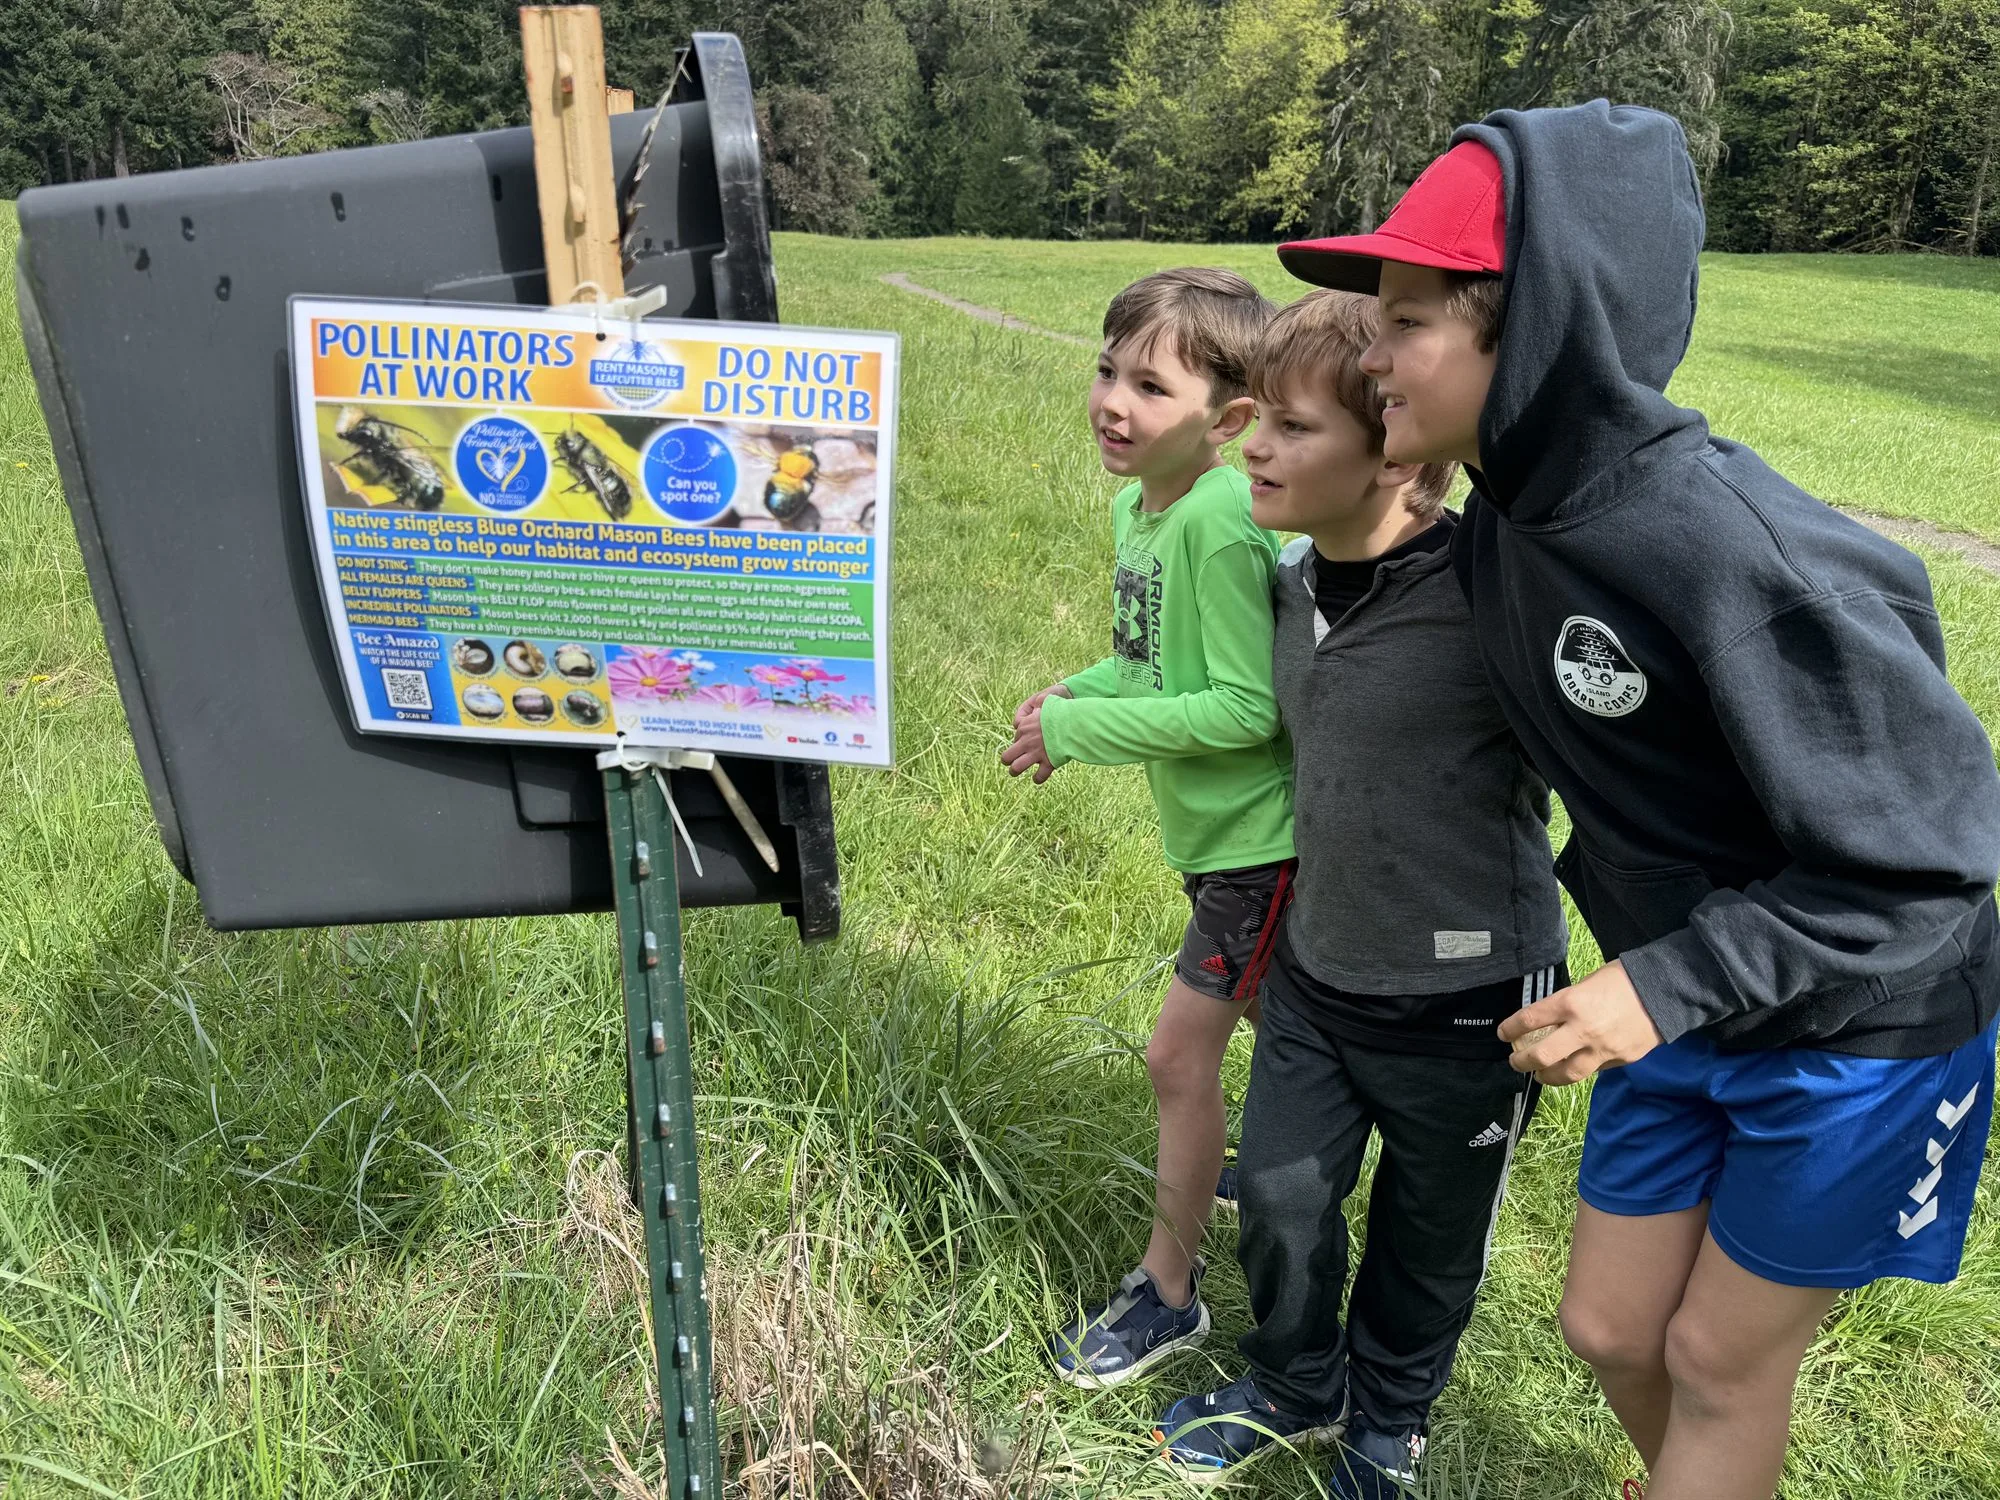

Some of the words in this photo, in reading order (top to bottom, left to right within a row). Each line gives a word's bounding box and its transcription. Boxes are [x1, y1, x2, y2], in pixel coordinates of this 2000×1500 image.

[319, 323, 574, 367] POLLINATORS
[595, 362, 624, 374] RENT
[626, 363, 666, 376] MASON
[669, 367, 679, 377] &
[718, 346, 771, 380] DO
[784, 350, 861, 385] NOT
[360, 363, 403, 396] AT
[414, 364, 532, 402] WORK
[595, 374, 653, 386] LEAFCUTTER
[655, 377, 679, 388] BEES
[704, 381, 871, 422] DISTURB
[472, 424, 527, 438] Pollinator
[463, 434, 507, 450] Friendly
[508, 438, 538, 453] Yard
[667, 476, 691, 490] Can
[692, 480, 717, 493] you
[479, 492, 496, 504] NO
[661, 491, 688, 504] spot
[690, 492, 721, 504] one?
[332, 512, 390, 530] Native
[394, 515, 473, 536] stingless
[477, 518, 518, 536] Blue
[522, 521, 594, 540] Orchard
[599, 525, 657, 544] Mason
[662, 528, 705, 546] Bees
[709, 531, 752, 549] have
[756, 534, 802, 552] been
[807, 537, 867, 556] placed
[333, 530, 350, 546] in
[354, 531, 388, 548] this
[392, 537, 430, 550] area
[434, 538, 452, 552] to
[456, 537, 497, 558] help
[501, 543, 530, 556] our
[535, 540, 600, 560] habitat
[604, 547, 638, 562] and
[641, 552, 738, 570] ecosystem
[742, 556, 788, 573] grow
[792, 559, 870, 578] stronger
[337, 557, 353, 567] DO
[354, 558, 376, 568] NOT
[377, 559, 408, 570] STING
[421, 562, 443, 575] They
[445, 564, 471, 574] don't
[474, 565, 499, 575] make
[500, 567, 531, 579] honey
[534, 568, 551, 579] and
[553, 570, 576, 580] have
[580, 572, 592, 580] no
[594, 572, 615, 582] hive
[629, 576, 661, 586] queen
[663, 578, 673, 586] to
[675, 579, 714, 589] protect,
[730, 580, 753, 593] they
[754, 583, 770, 591] are
[772, 583, 850, 596] non-aggressive.
[341, 571, 358, 582] ALL
[359, 572, 403, 584] FEMALES
[405, 575, 424, 585] ARE
[426, 576, 467, 588] QUEENS
[479, 579, 502, 592] They
[504, 582, 520, 590] are
[522, 583, 560, 596] solitary
[590, 586, 613, 597] each
[615, 588, 649, 599] female
[651, 591, 671, 602] lays
[673, 591, 689, 601] her
[691, 595, 713, 603] own
[715, 596, 737, 607] eggs
[740, 596, 758, 605] and
[760, 596, 784, 606] finds
[786, 598, 803, 608] her
[805, 602, 826, 610] own
[828, 602, 852, 611] nest.
[342, 585, 370, 596] BELLY
[372, 587, 422, 599] FLOPPERS
[432, 591, 464, 602] Mason
[466, 593, 489, 603] bees
[490, 594, 518, 605] BELLY
[520, 596, 544, 606] FLOP
[547, 599, 569, 608] onto
[571, 599, 608, 610] flowers
[610, 603, 627, 612] and
[629, 605, 646, 615] get
[648, 606, 679, 616] pollen
[681, 607, 694, 616] all
[696, 609, 717, 617] over
[720, 609, 742, 619] their
[745, 610, 770, 623] body
[772, 612, 796, 622] hairs
[798, 613, 828, 623] called
[829, 615, 865, 626] SCOPA.
[346, 600, 403, 612] INCREDIBLE
[404, 603, 472, 616] POLLINATORS
[482, 609, 513, 619] Mason
[515, 610, 538, 620] bees
[541, 612, 561, 622] visit
[564, 614, 591, 624] 2,000
[593, 616, 630, 626] flowers
[659, 621, 677, 629] and
[678, 622, 722, 632] pollinate
[725, 624, 749, 634] 95%
[750, 626, 760, 634] of
[762, 627, 816, 639] everything
[818, 629, 840, 641] they
[1150, 555, 1163, 692] ARMOUR
[348, 614, 394, 625] MERMAID
[395, 617, 419, 627] BEES
[429, 618, 451, 631] They
[454, 620, 476, 630] have
[485, 623, 510, 634] shiny
[512, 624, 577, 636] greenish-blue
[580, 628, 602, 640] body
[605, 631, 622, 640] and
[624, 632, 644, 641] look
[646, 633, 663, 642] like
[673, 634, 701, 644] house
[704, 636, 716, 647] fly
[730, 640, 777, 648] mermaids
[354, 632, 381, 645] Bee
[384, 634, 439, 648] Amazed
[360, 648, 384, 656] WATCH
[402, 650, 417, 658] LIFE
[419, 651, 440, 659] CYCLE
[388, 658, 415, 666] MASON
[1563, 673, 1594, 708] BOARD
[1604, 684, 1638, 710] CORPS
[1586, 688, 1610, 697] ISLAND
[640, 716, 671, 725] LEARN
[672, 718, 696, 727] HOW
[699, 720, 711, 728] TO
[712, 720, 737, 730] HOST
[740, 723, 762, 732] BEES
[1200, 960, 1228, 976] adidas
[1469, 1130, 1508, 1147] adidas
